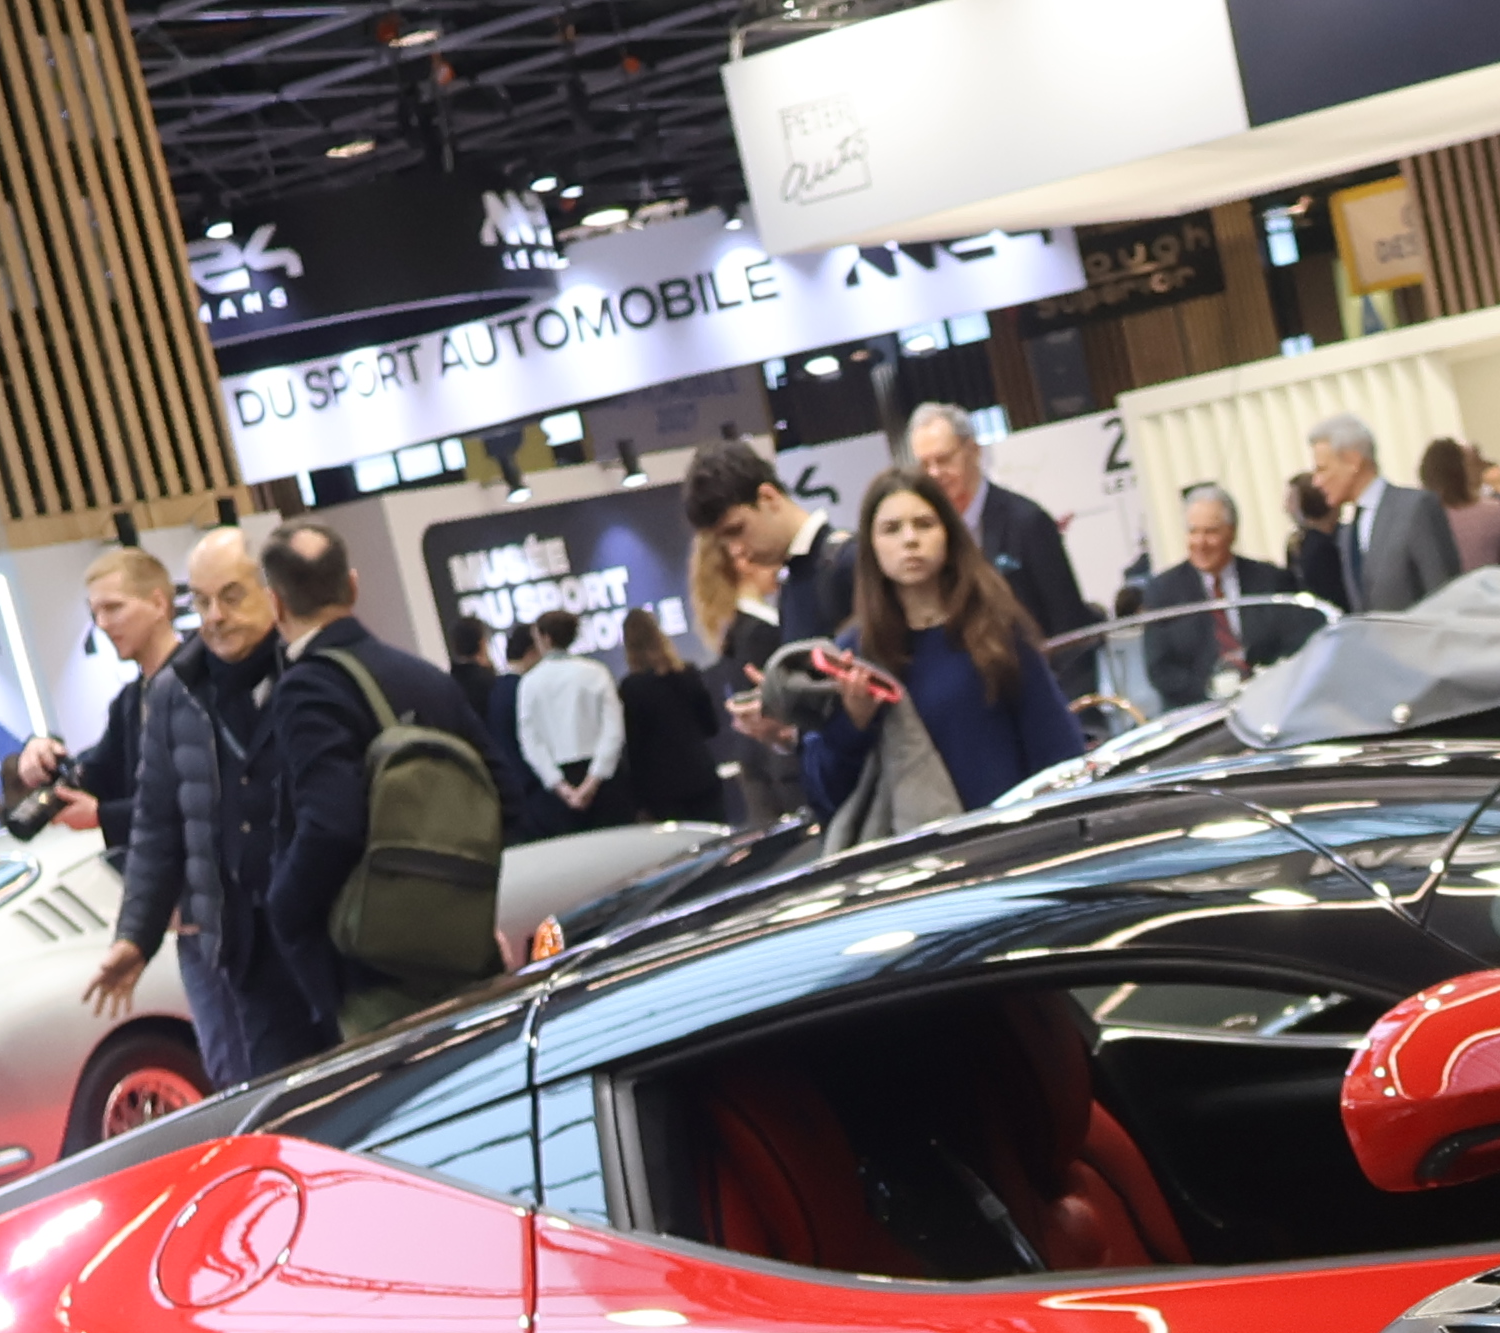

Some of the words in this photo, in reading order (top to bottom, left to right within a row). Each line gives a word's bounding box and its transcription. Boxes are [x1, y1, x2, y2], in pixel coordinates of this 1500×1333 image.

[234, 379, 296, 428] DU
[304, 344, 422, 411] SPORT
[441, 258, 781, 376] AUTOMOBILE
[448, 532, 572, 594] MUSÉE
[512, 565, 630, 626] SPORT
